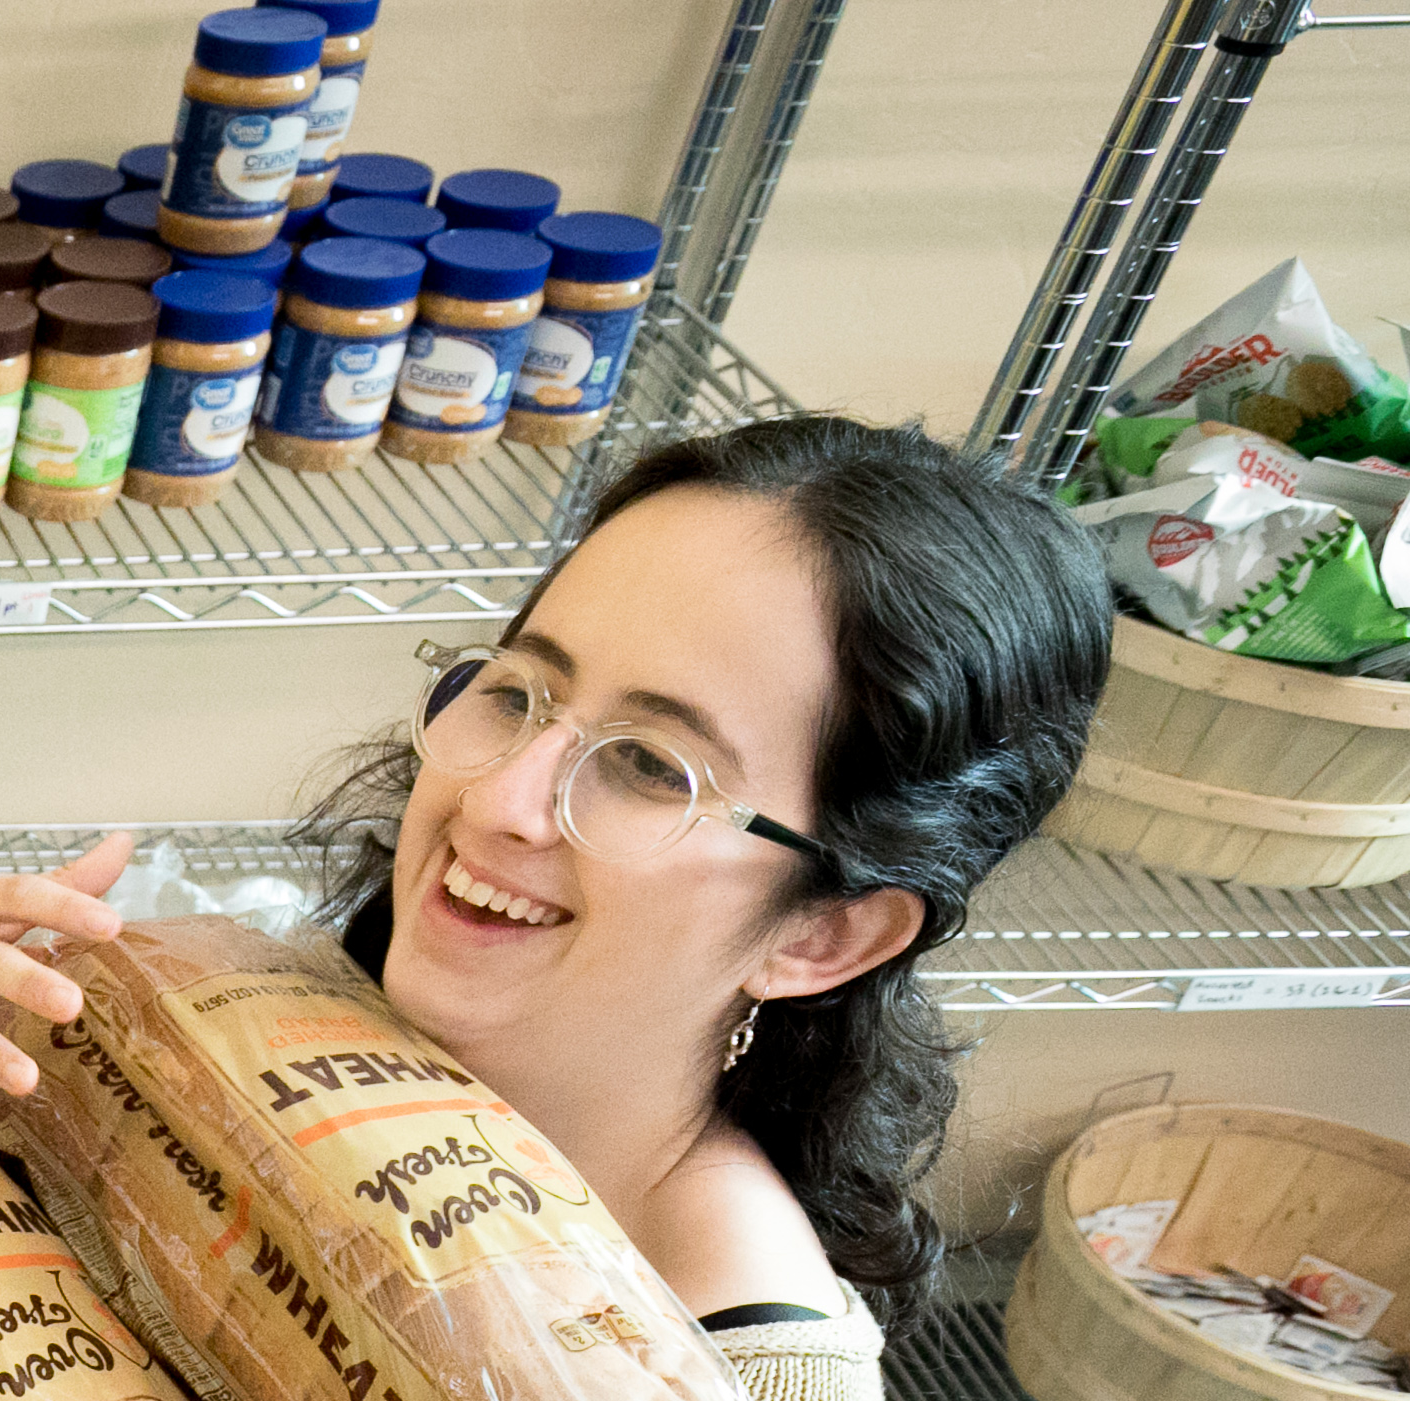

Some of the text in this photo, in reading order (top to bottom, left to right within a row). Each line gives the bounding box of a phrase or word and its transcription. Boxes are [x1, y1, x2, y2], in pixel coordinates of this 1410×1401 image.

[409, 364, 477, 388] Crunchy
[192, 993, 229, 1013] 567g
[258, 1051, 476, 1114] WHEAT
[354, 1136, 493, 1215] Fresh
[410, 1167, 542, 1250] Oven
